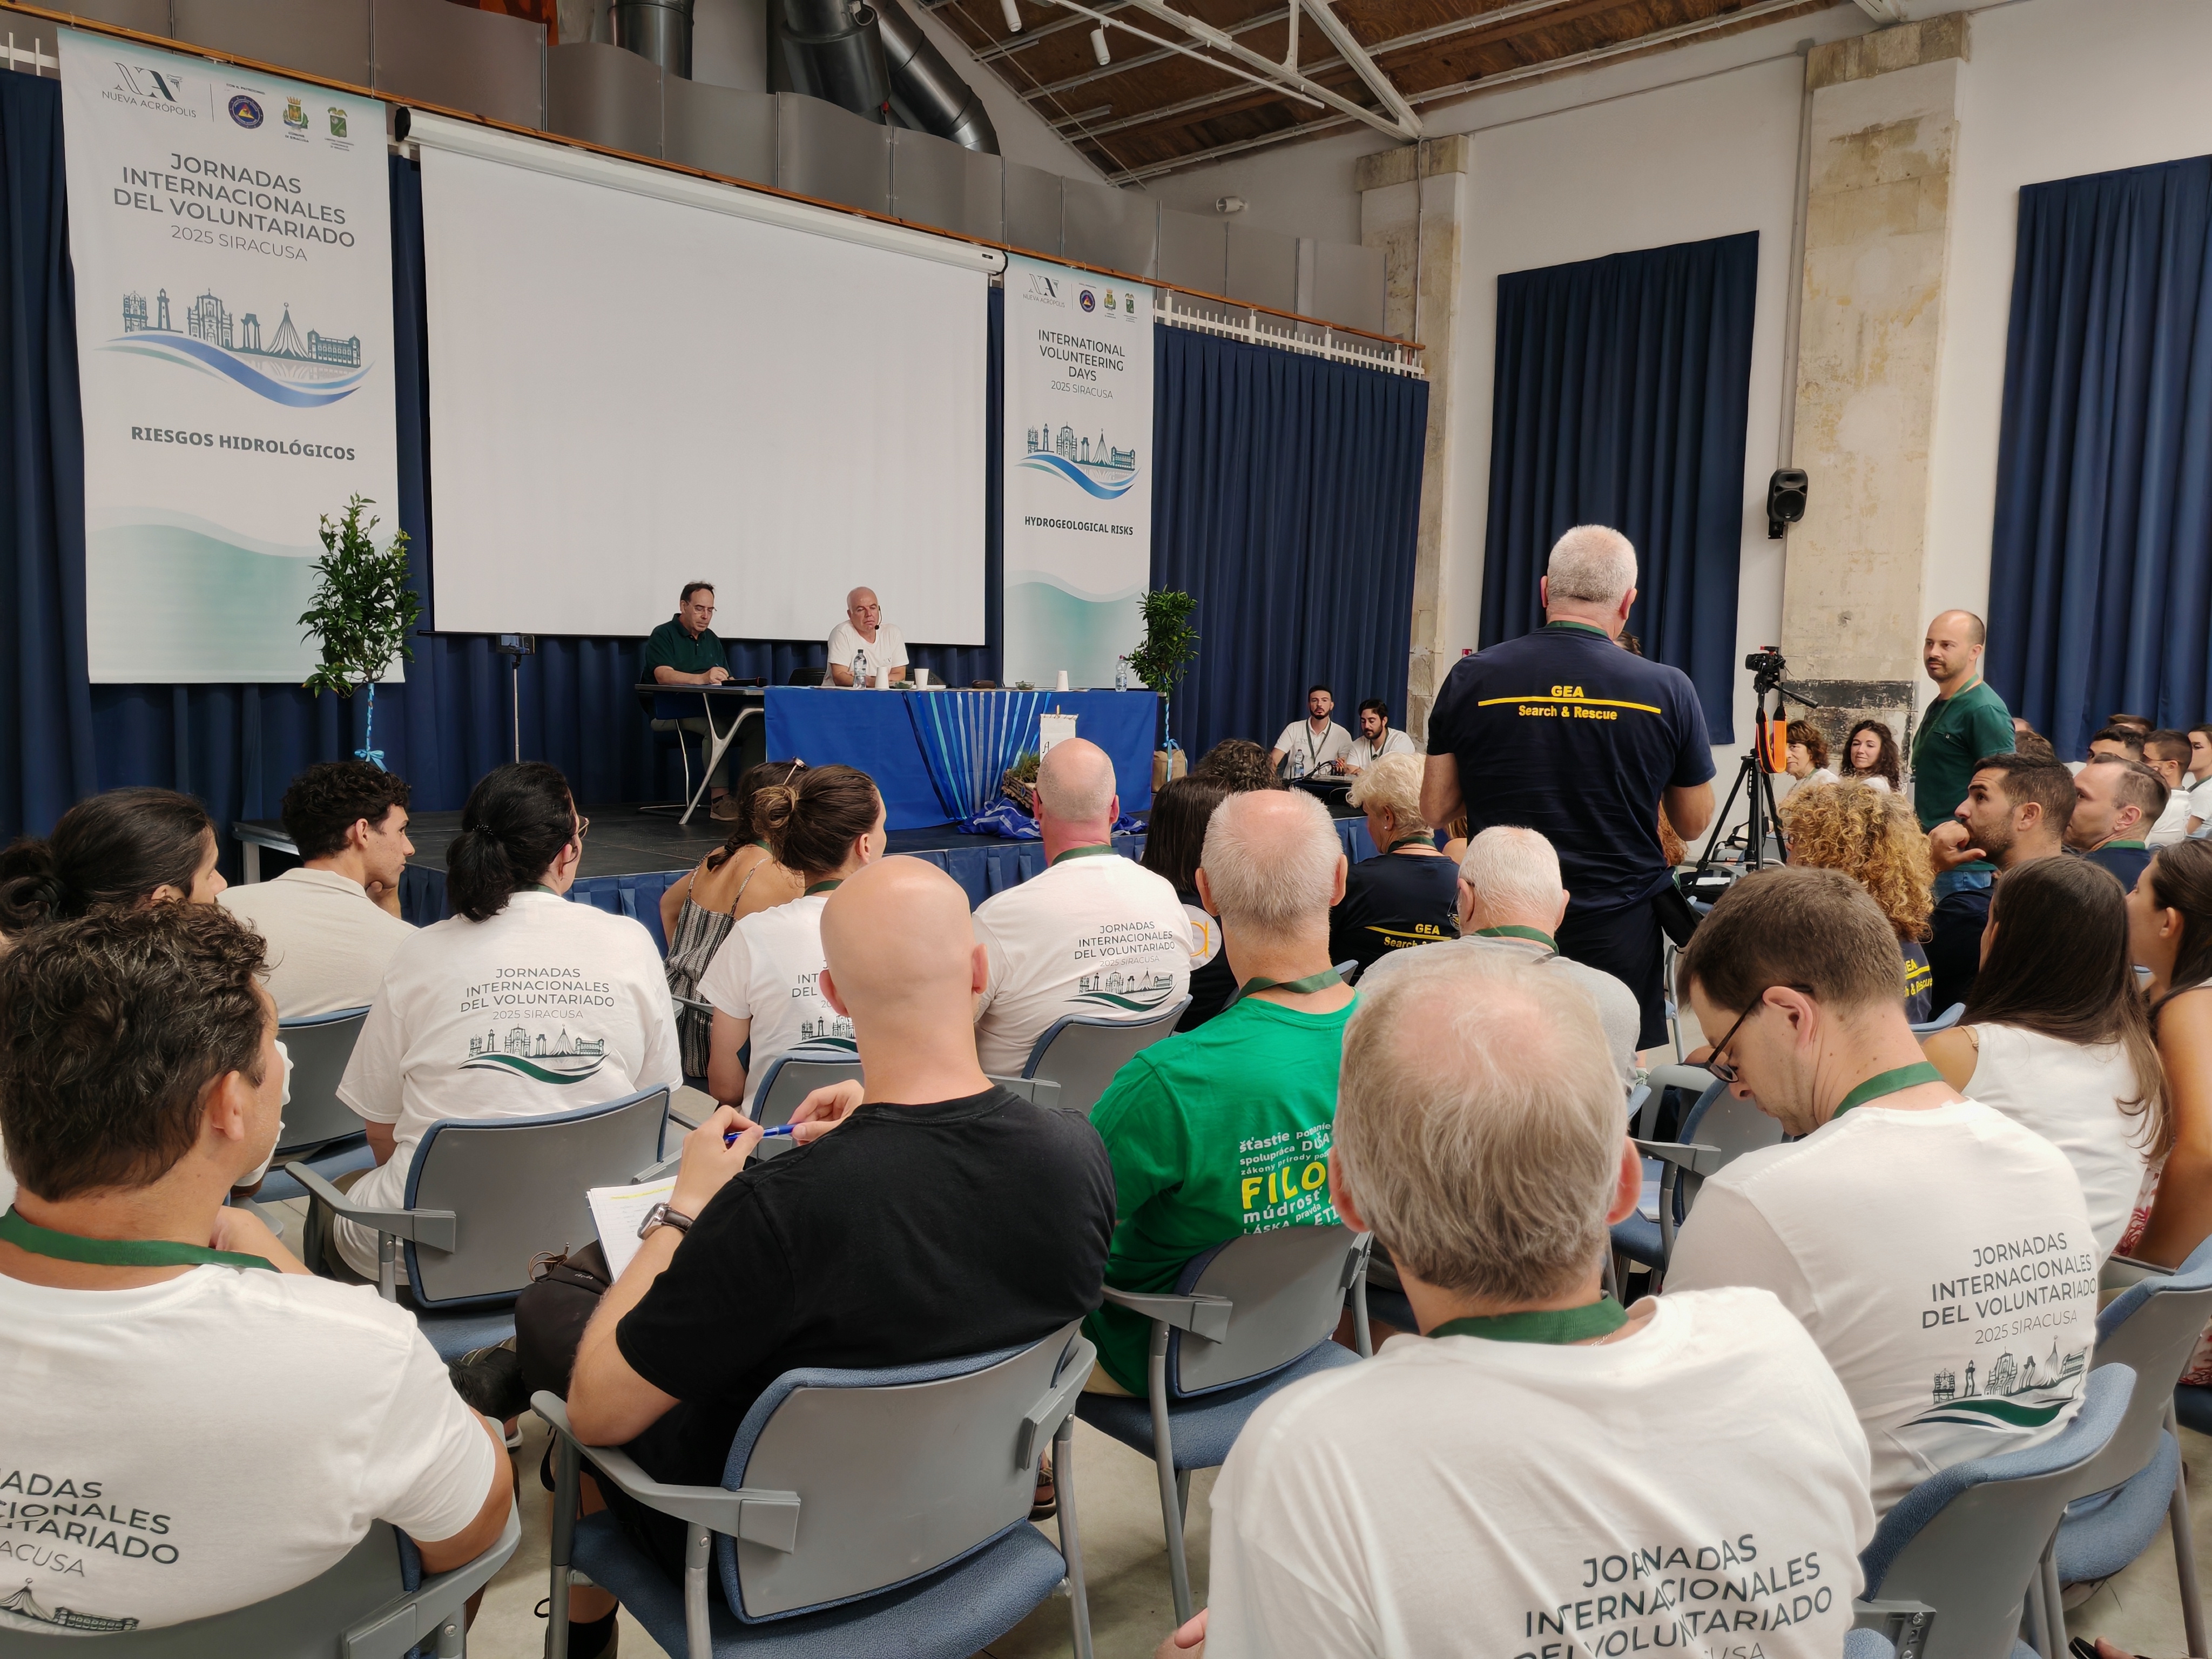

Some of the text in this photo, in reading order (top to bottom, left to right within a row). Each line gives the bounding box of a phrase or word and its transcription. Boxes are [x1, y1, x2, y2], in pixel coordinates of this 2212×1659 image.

[102, 90, 197, 118] NUEVA ACRÓPOLIS
[171, 153, 301, 194] JORNADAS
[123, 166, 346, 225] INTERNACIONALES
[113, 188, 355, 247] DEL VOLUNTARIADO
[171, 225, 308, 262] 2025 SIRACUSA
[1023, 294, 1040, 302] NUEVA
[1038, 329, 1125, 357] INTERNATIONAL
[1040, 345, 1123, 371] VOLUNTEERING
[1069, 366, 1097, 381] DAYS
[1051, 381, 1114, 399] 2025 SIRACUSA
[131, 426, 355, 461] RIESGOS HIDROLÓGICOS
[1025, 516, 1134, 535] HYDROGEOLOGICAL RISKS
[1551, 685, 1584, 698] GEA
[1519, 705, 1617, 720] Search & Rescue
[1100, 921, 1155, 934] JORNADAS
[1415, 923, 1440, 935] GEA
[1079, 931, 1173, 947] INTERNACIONALES
[1075, 941, 1175, 960] DEL VOLUNTARIADO
[1100, 955, 1160, 967] 2025 SIRACUSA
[496, 968, 581, 978] JORNADAS
[1904, 959, 1918, 972] EA
[466, 981, 610, 997] INTERNACIONALES
[792, 987, 818, 997] DEL
[461, 994, 615, 1013] DEL VOLUNTARIADO
[493, 1009, 583, 1020] 2025 SIRACUSA
[1239, 1132, 1290, 1154] šťastie
[1239, 1144, 1295, 1166] spolupráca
[1240, 1163, 1276, 1176] zákony
[1278, 1154, 1311, 1168] prírody
[1242, 1161, 1326, 1210] FILO
[1243, 1186, 1323, 1224] múdrosť
[1296, 1203, 1321, 1223] pravda
[1973, 1232, 2067, 1267] JORNADAS
[1932, 1253, 2092, 1302] INTERNACIONALES
[1922, 1277, 2096, 1329] DEL VOLUNTARIADO
[1974, 1310, 2078, 1344] 2025 SIRACUSA
[0, 1467, 103, 1499] ADAS
[0, 1500, 171, 1535] IONALES
[1582, 1533, 1757, 1588] JORNADAS
[1526, 1552, 1820, 1638] INTERNACIONALES
[1583, 1586, 1832, 1658] VOLUNTARIADO
